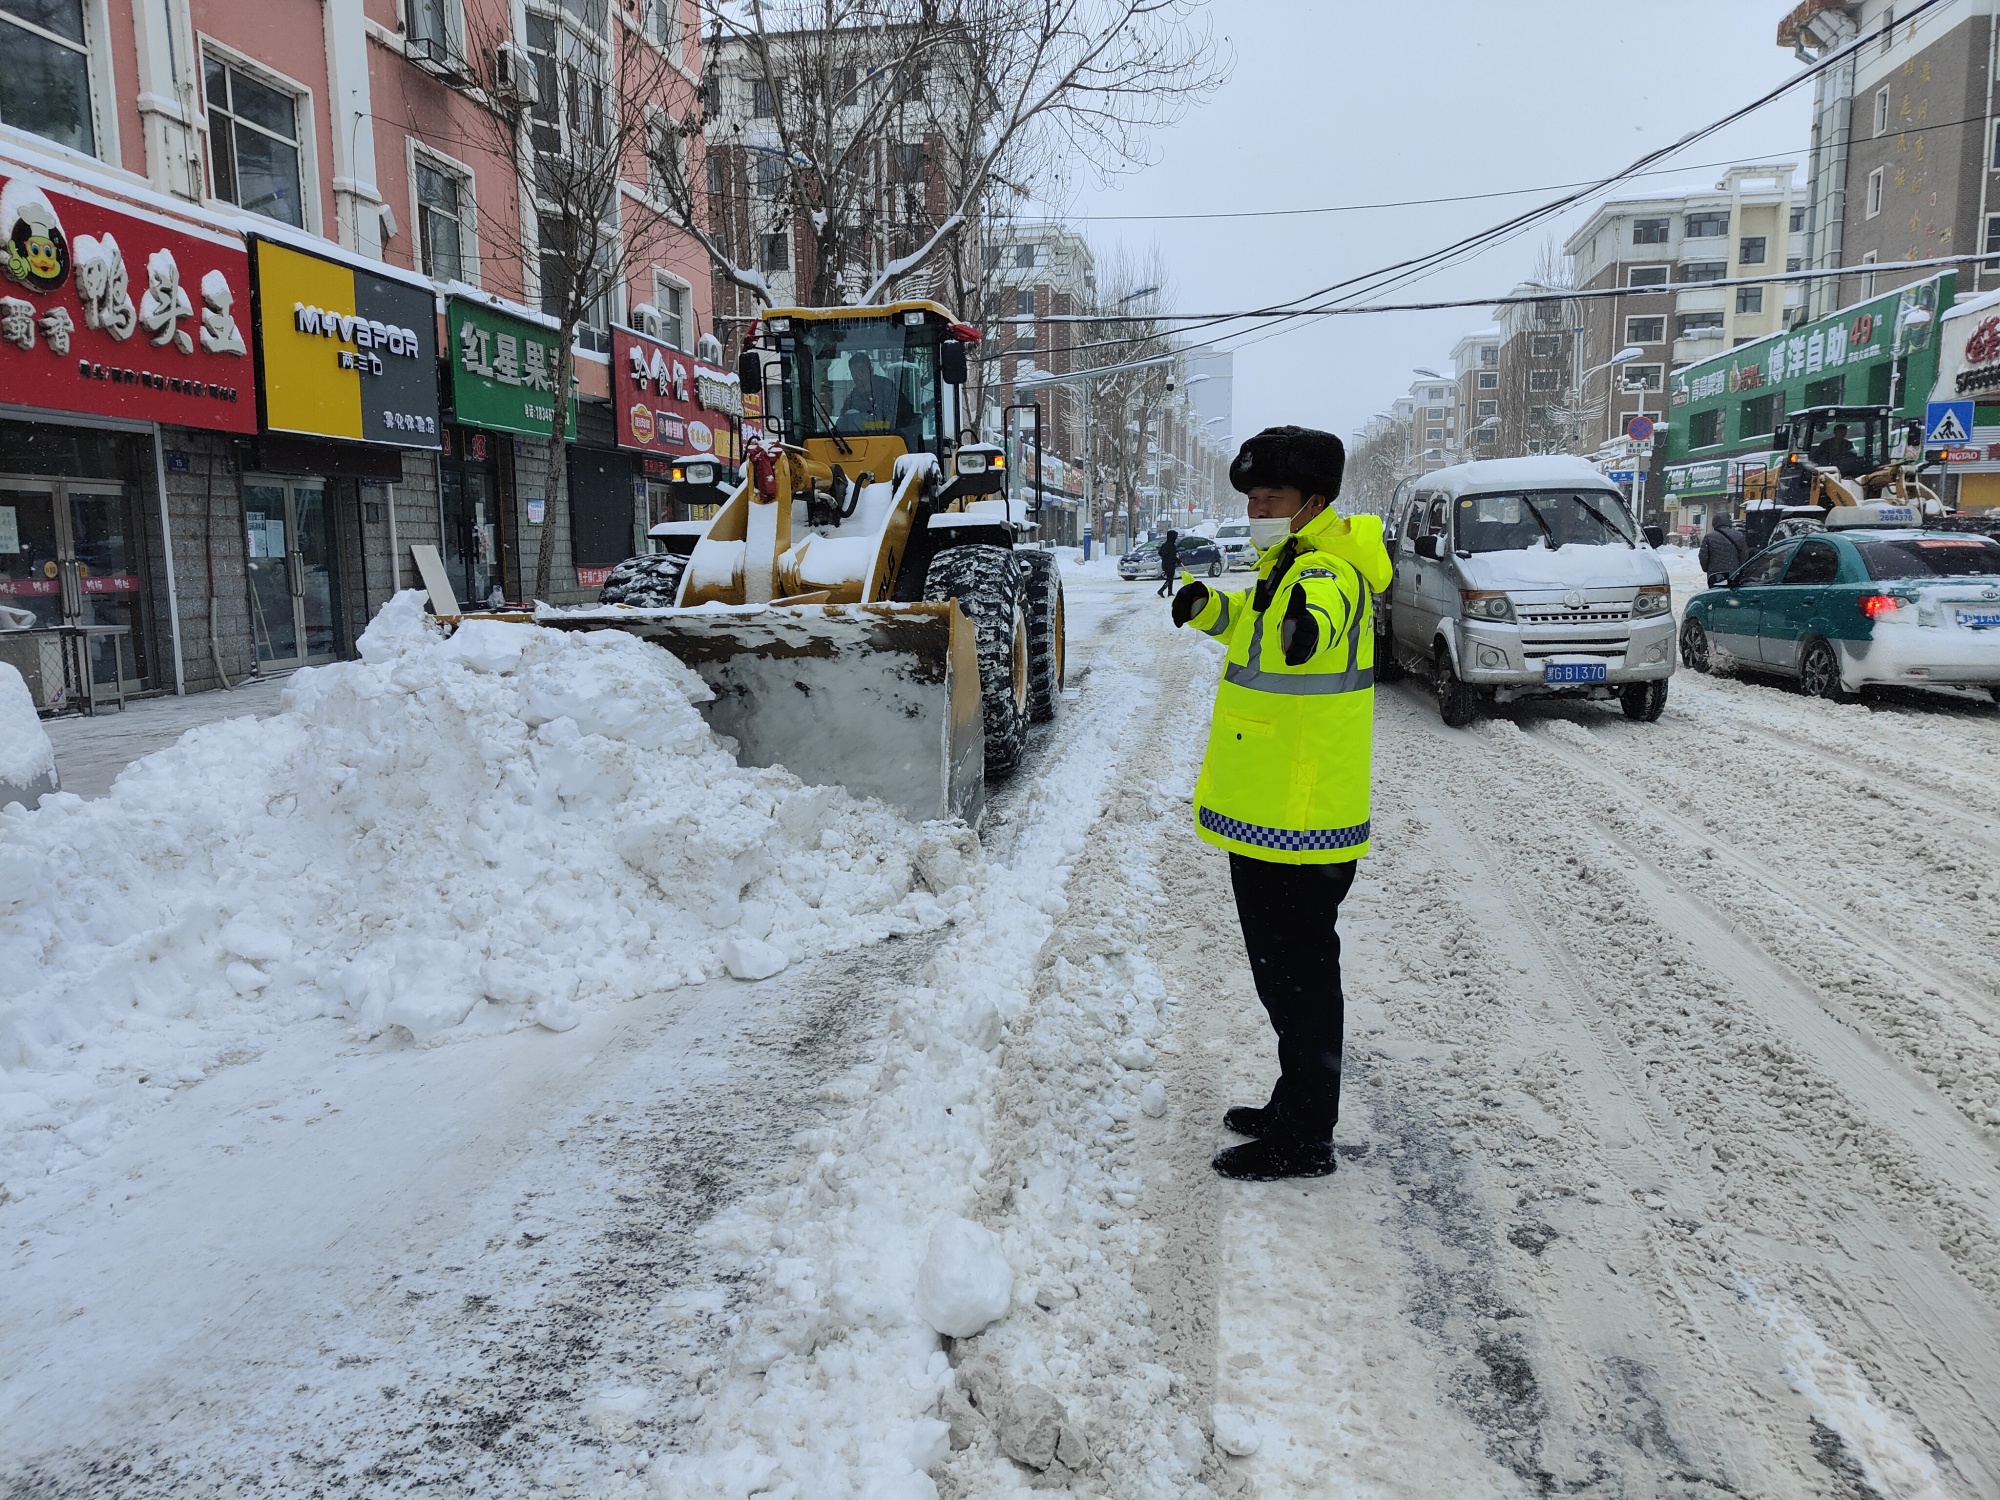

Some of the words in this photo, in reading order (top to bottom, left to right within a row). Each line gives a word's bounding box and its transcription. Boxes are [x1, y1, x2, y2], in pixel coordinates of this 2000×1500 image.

[73, 238, 248, 356] 鸭头王
[0, 297, 75, 355] 蜀香
[1850, 313, 1872, 346] 49
[461, 320, 572, 398] 红星果
[1767, 322, 1848, 386] 博洋自助
[1691, 369, 1725, 402] 青岛啤酒
[175, 459, 183, 467] 15
[1879, 514, 1913, 522] 2664370
